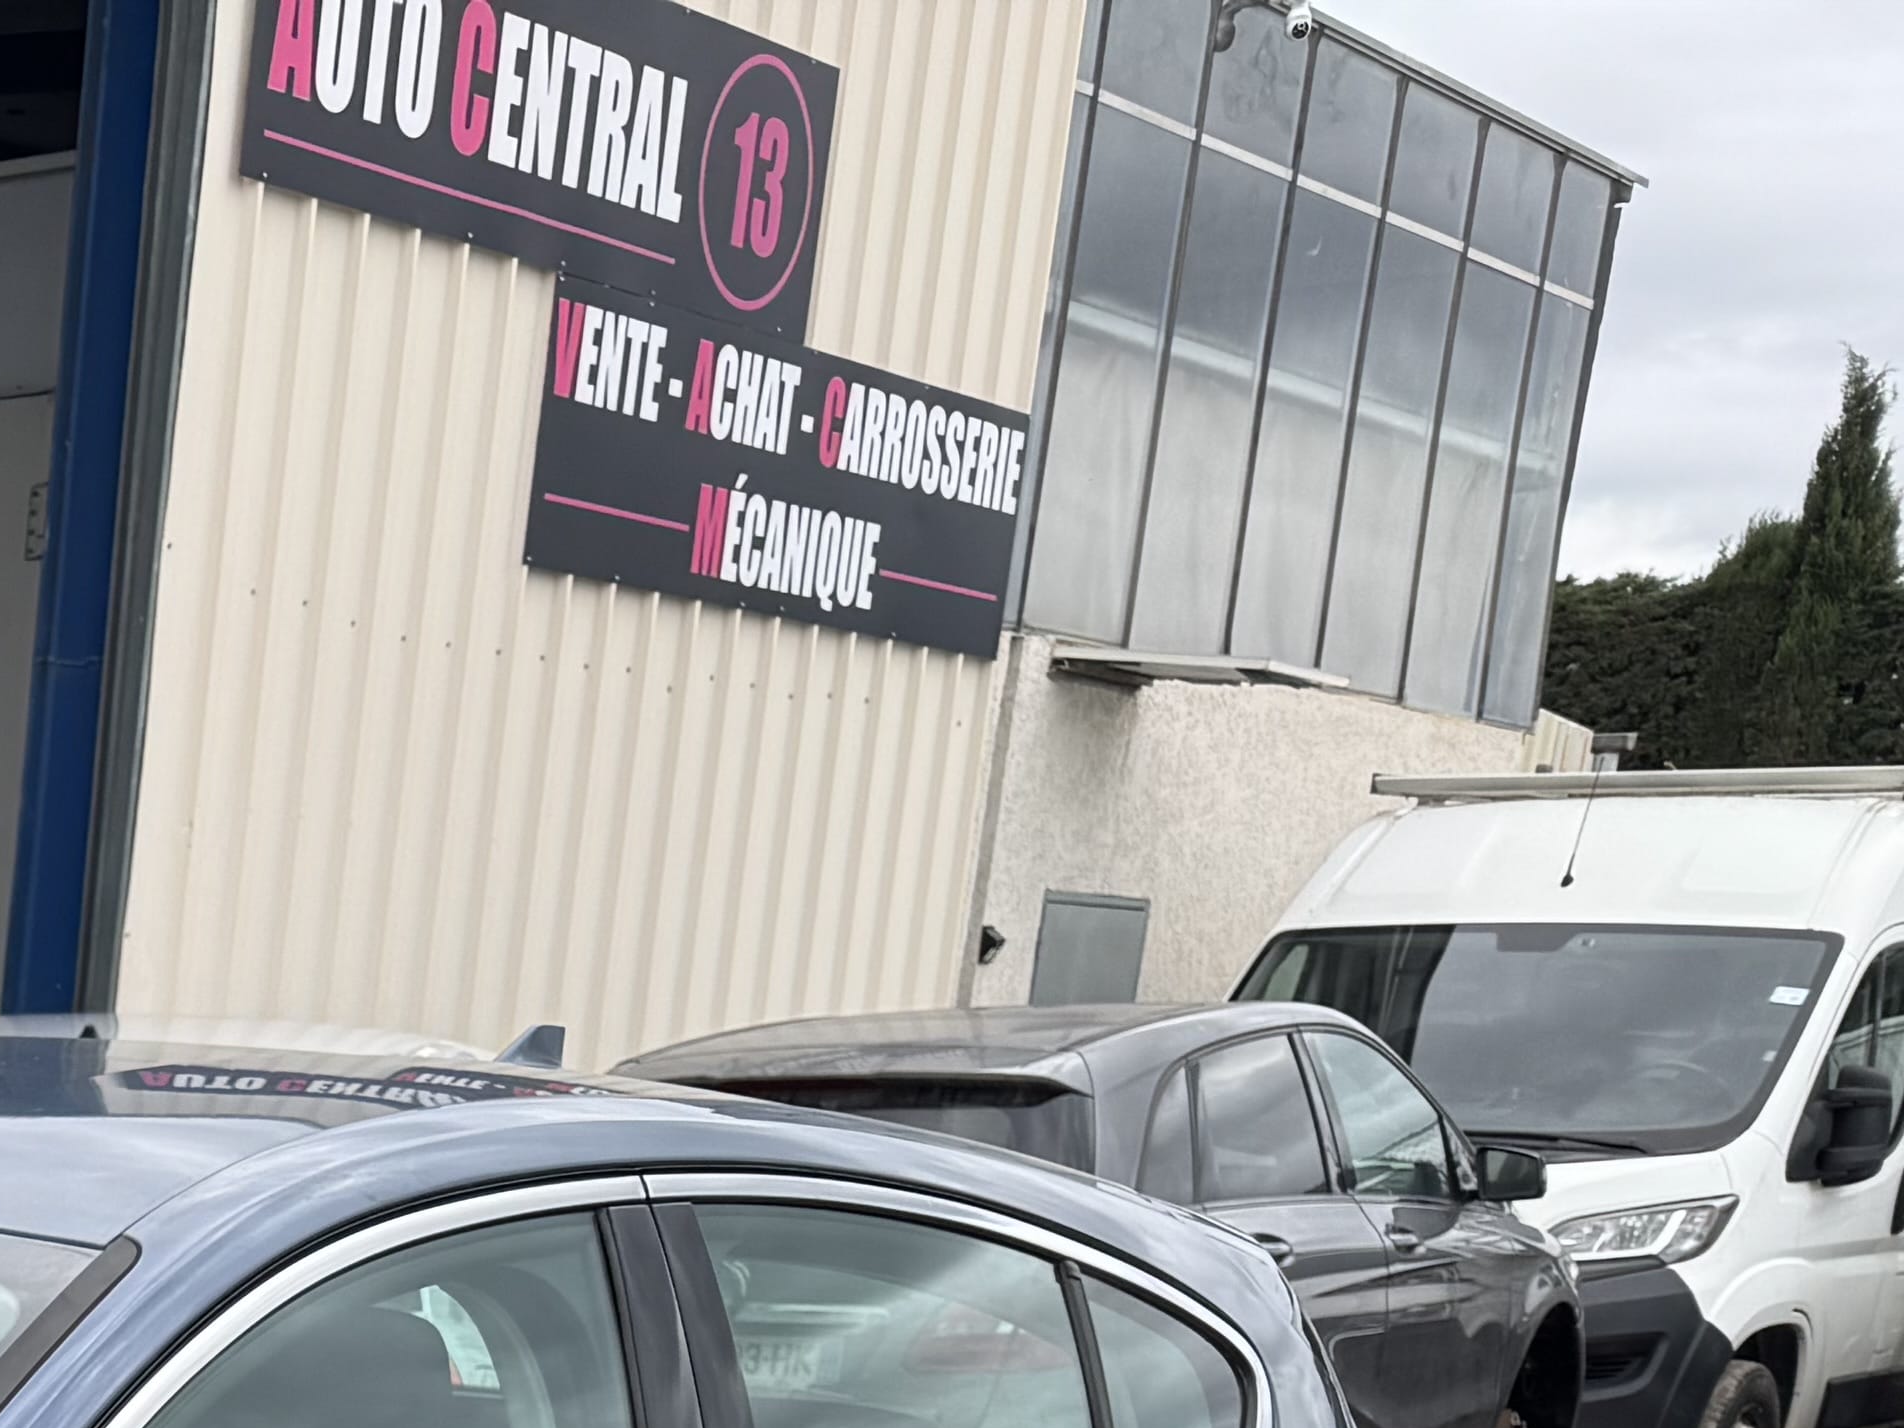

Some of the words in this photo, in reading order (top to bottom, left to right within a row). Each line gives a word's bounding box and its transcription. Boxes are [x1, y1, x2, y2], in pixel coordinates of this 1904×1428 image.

[449, 0, 689, 224] CENTRAL
[730, 112, 790, 258] 13
[553, 297, 668, 423] VENTE
[684, 338, 803, 455] ACHAT
[818, 376, 1026, 516] CARROSSERIE
[690, 473, 882, 612] MÉCANIQUE
